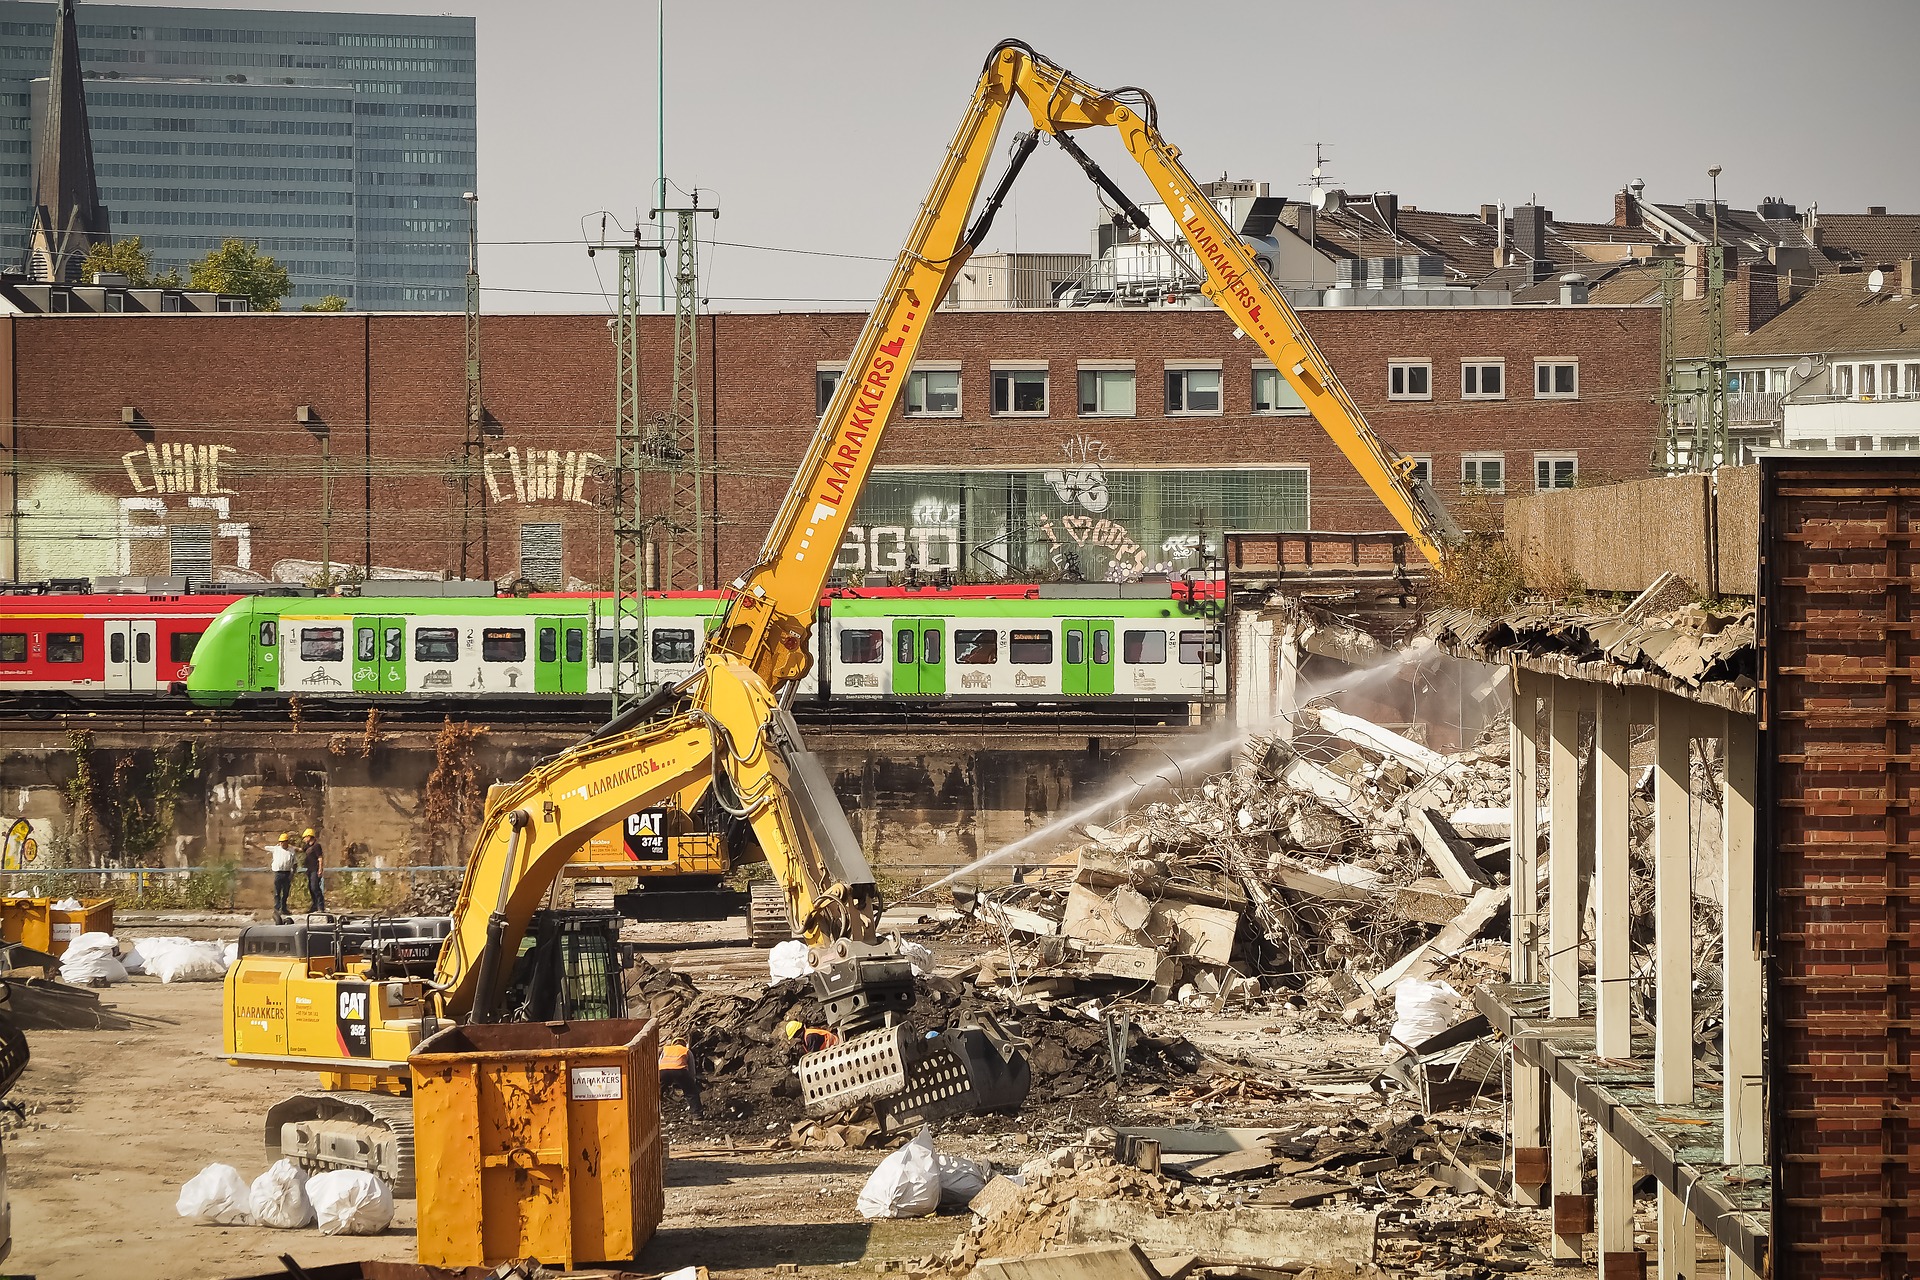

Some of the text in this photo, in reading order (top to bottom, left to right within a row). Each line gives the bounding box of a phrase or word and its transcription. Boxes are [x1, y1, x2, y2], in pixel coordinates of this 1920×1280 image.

[1186, 217, 1256, 309] LAARAKKERS
[820, 356, 895, 505] LAARAKKERS
[33, 633, 39, 643] 1
[290, 628, 296, 639] 1
[466, 628, 474, 639] 2
[1000, 630, 1007, 640] 2
[1168, 631, 1176, 641] 2
[587, 760, 651, 798] LAARAKKERS
[628, 813, 663, 836] CAT
[641, 837, 663, 847] 374F
[340, 991, 366, 1020] CAT
[237, 1006, 285, 1020] LAARAKKERS
[573, 1077, 619, 1085] LAARAKKERS
